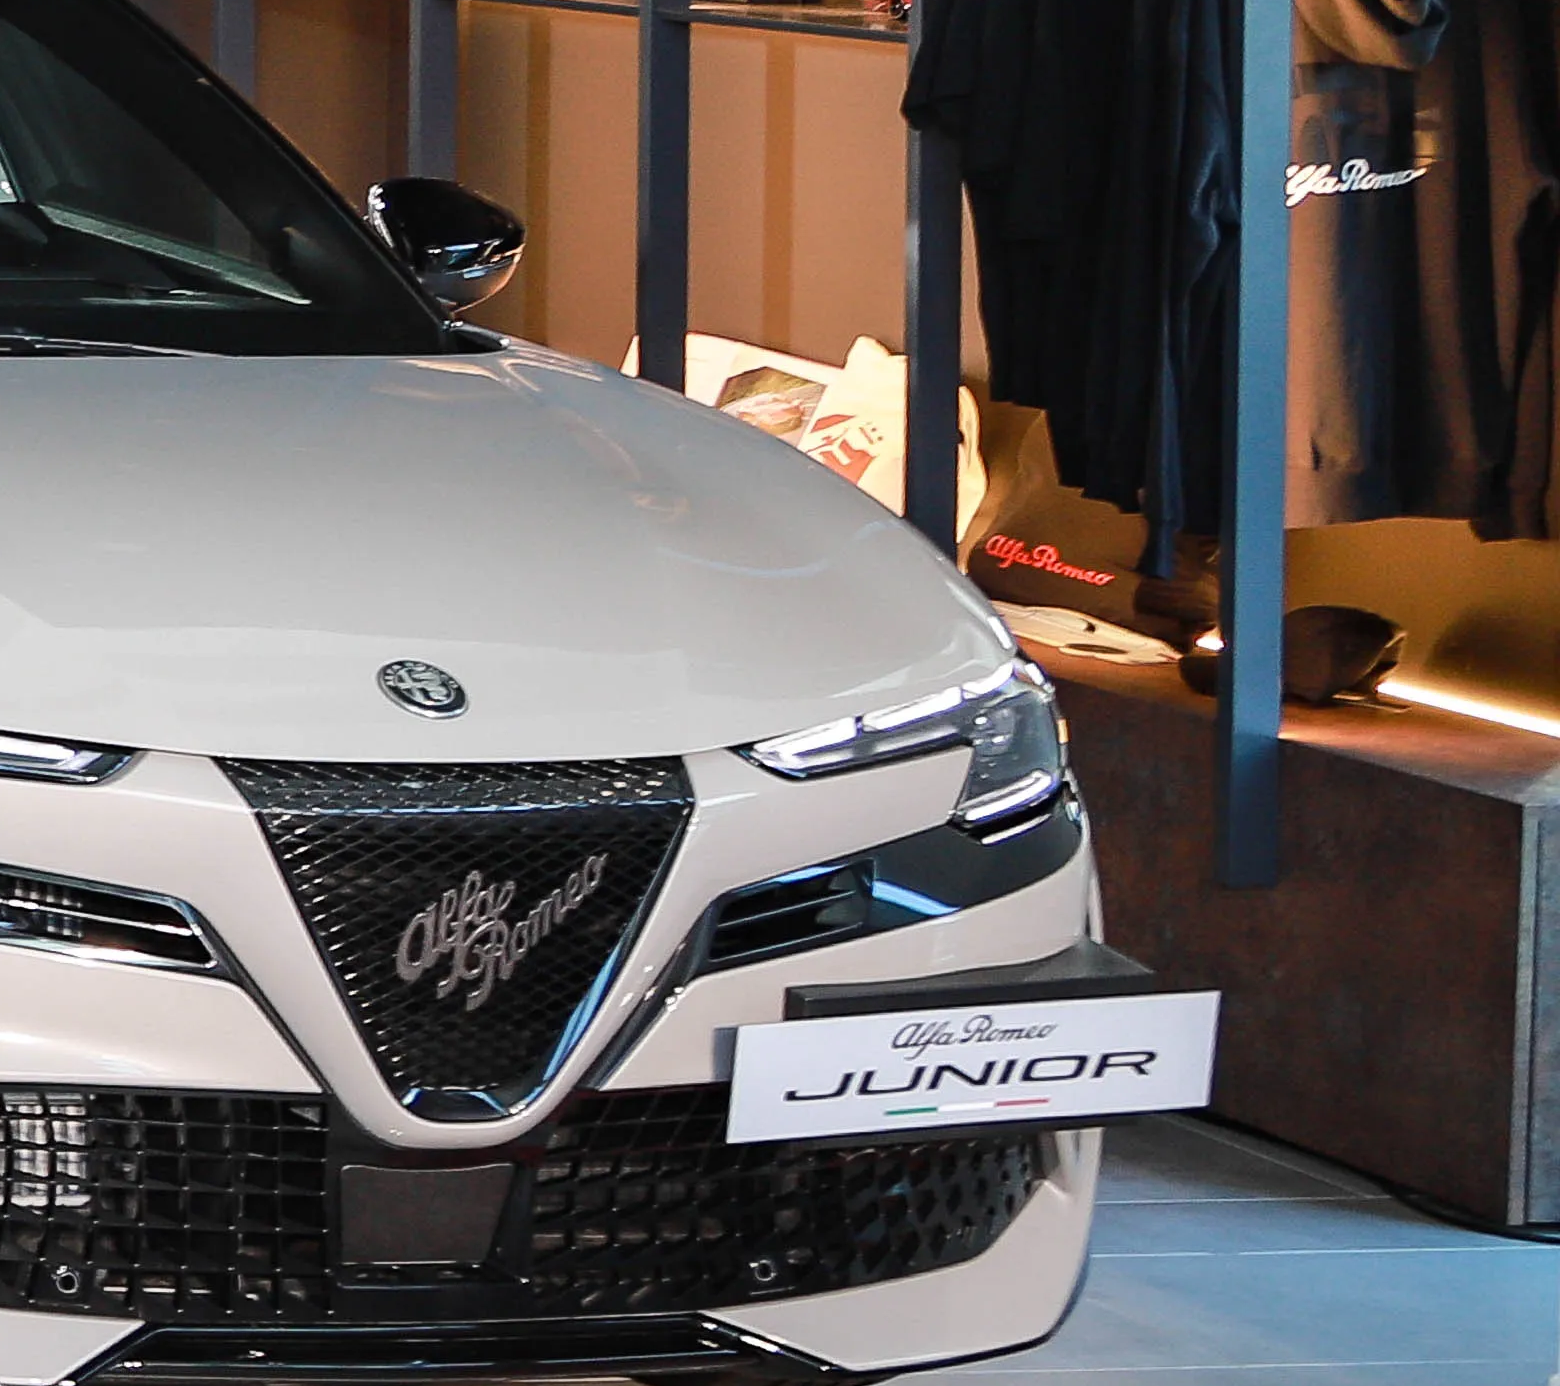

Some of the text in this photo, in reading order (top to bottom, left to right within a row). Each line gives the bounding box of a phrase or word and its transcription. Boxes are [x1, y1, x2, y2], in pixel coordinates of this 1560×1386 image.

[985, 534, 1116, 587] Alfa Romeo
[394, 853, 608, 1011] Alfa Romeo
[891, 1014, 1058, 1060] Alfa Romeo
[783, 1050, 1158, 1102] JUNIOR
